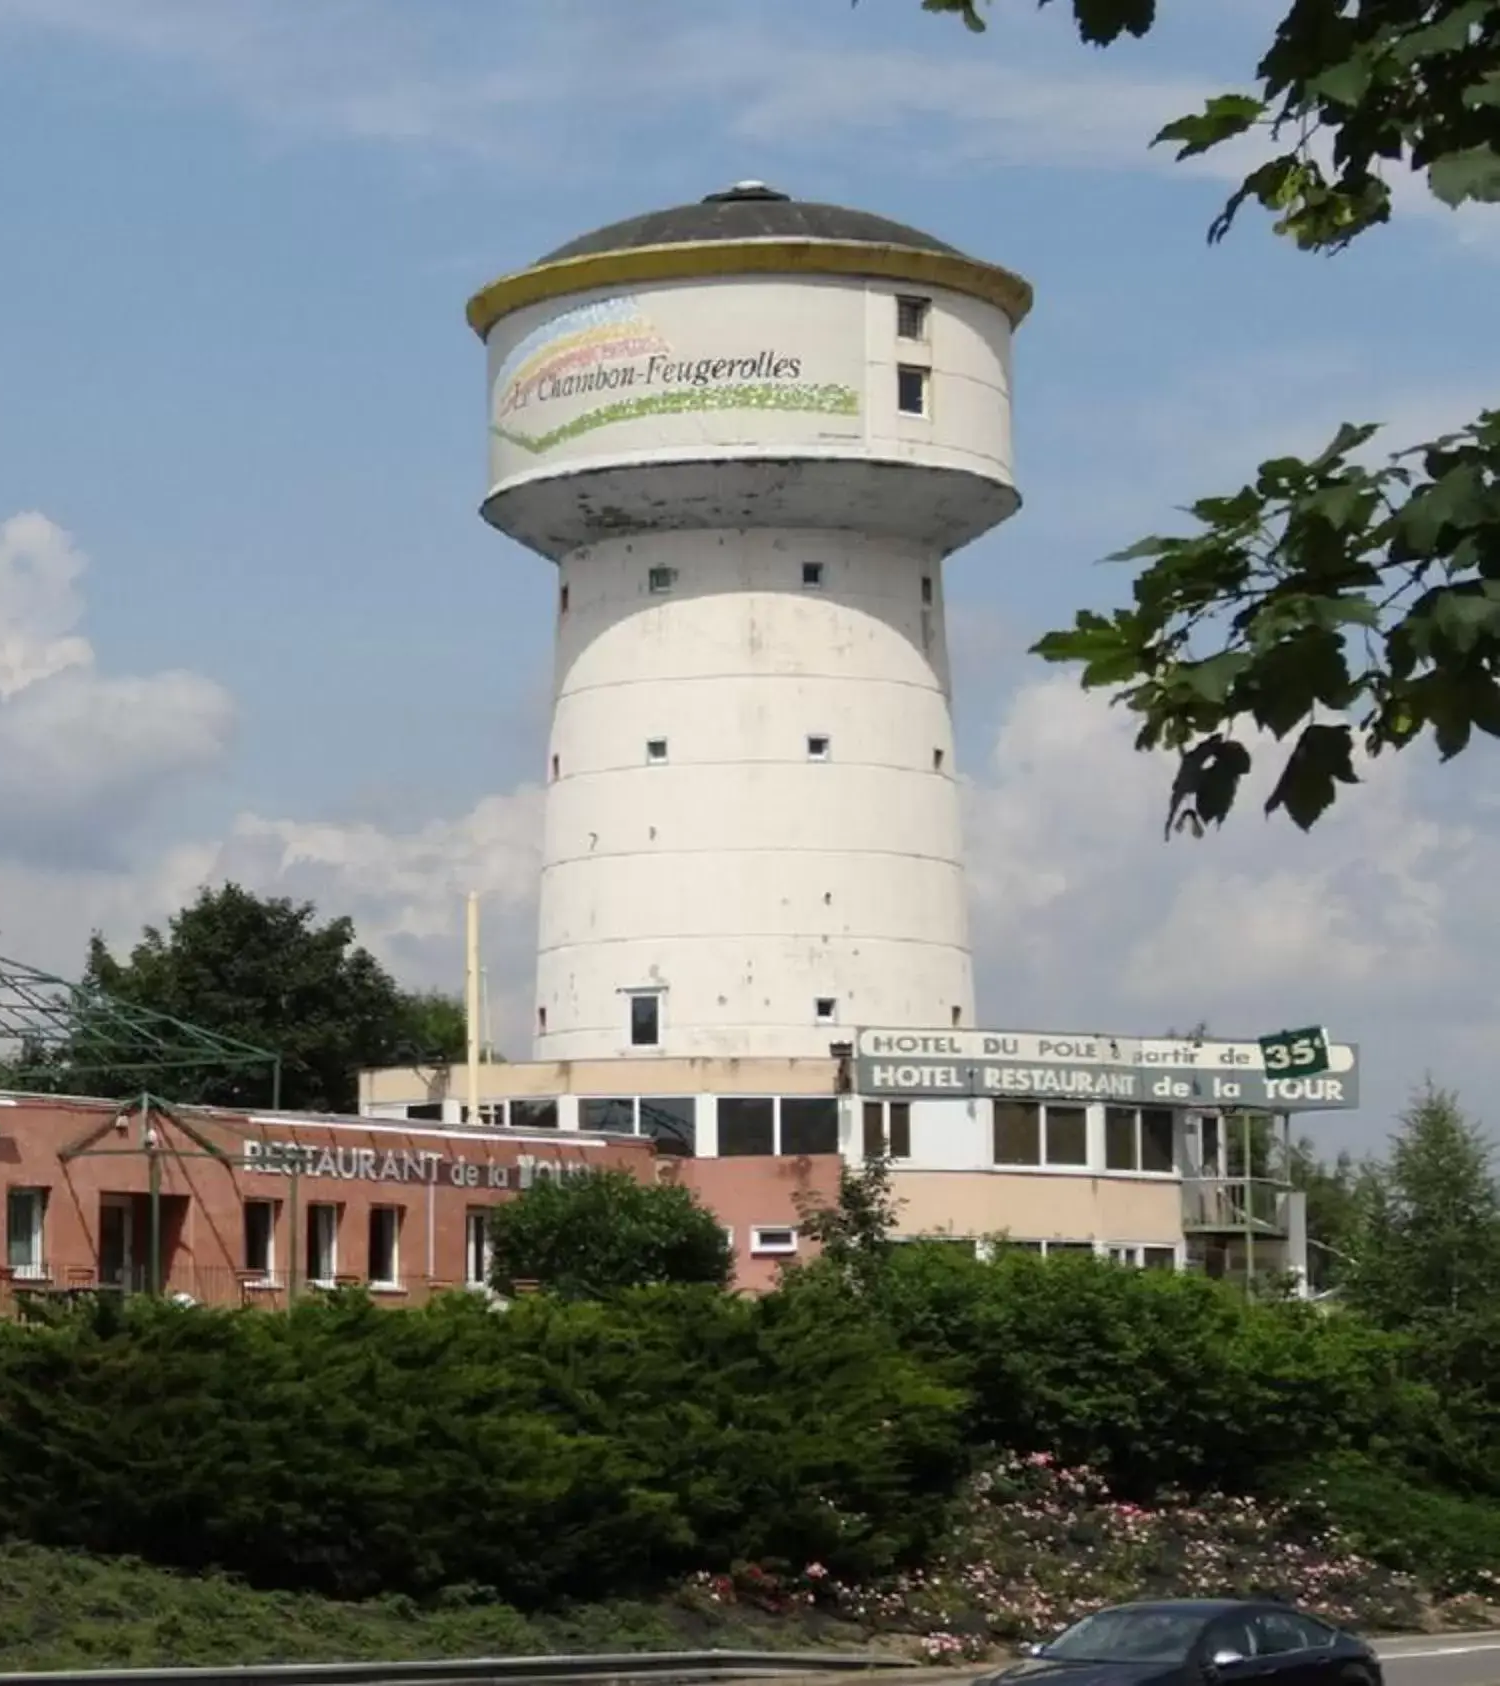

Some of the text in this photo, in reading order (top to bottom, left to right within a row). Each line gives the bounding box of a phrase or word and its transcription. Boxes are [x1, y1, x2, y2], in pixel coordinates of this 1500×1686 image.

[538, 350, 802, 401] Chambon-Feugerolles
[873, 1035, 962, 1054] HOTEL
[983, 1037, 1019, 1055] DU
[1038, 1039, 1098, 1058] POLE
[1219, 1047, 1251, 1066] de
[872, 1065, 1345, 1101] HOTEL RESTAURANT de la TOUR
[243, 1139, 444, 1183] RESTAURANT
[450, 1154, 480, 1186] de
[488, 1156, 509, 1187] la
